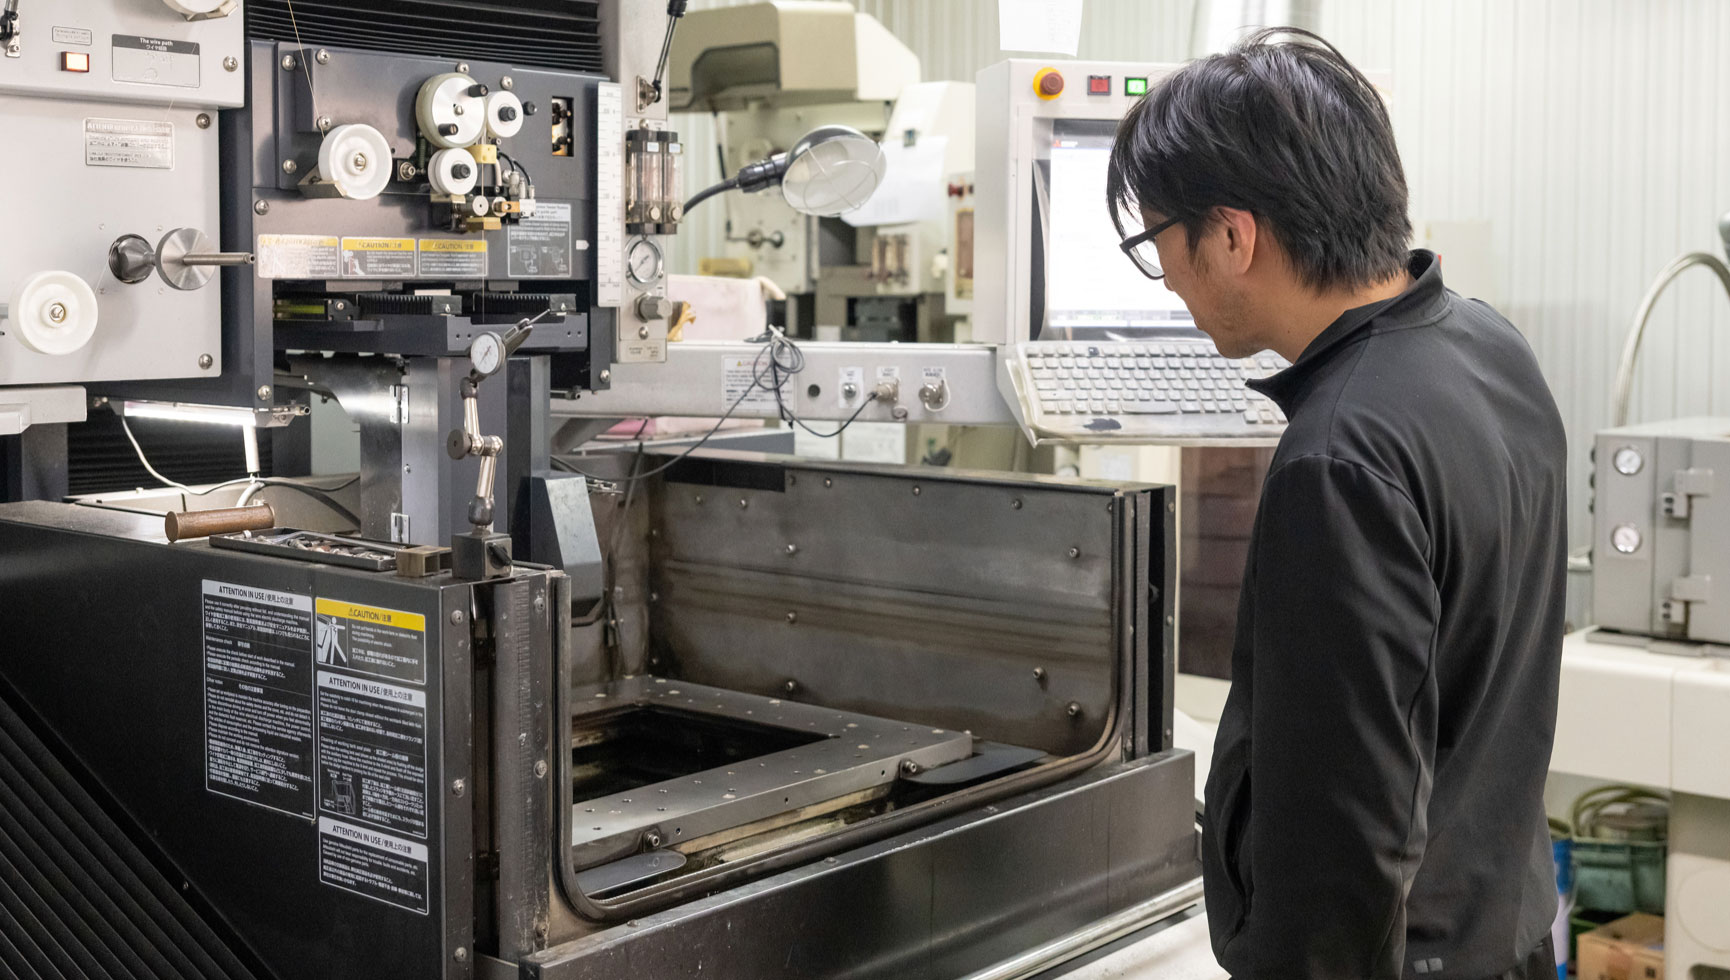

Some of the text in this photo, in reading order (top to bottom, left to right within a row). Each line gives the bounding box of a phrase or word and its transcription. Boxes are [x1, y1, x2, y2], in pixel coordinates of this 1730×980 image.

[218, 585, 248, 598] ATTENTION
[328, 676, 361, 691] ATTENTION
[361, 684, 368, 692] IN
[332, 824, 362, 840] ATTENTION
[363, 833, 370, 842] IN
